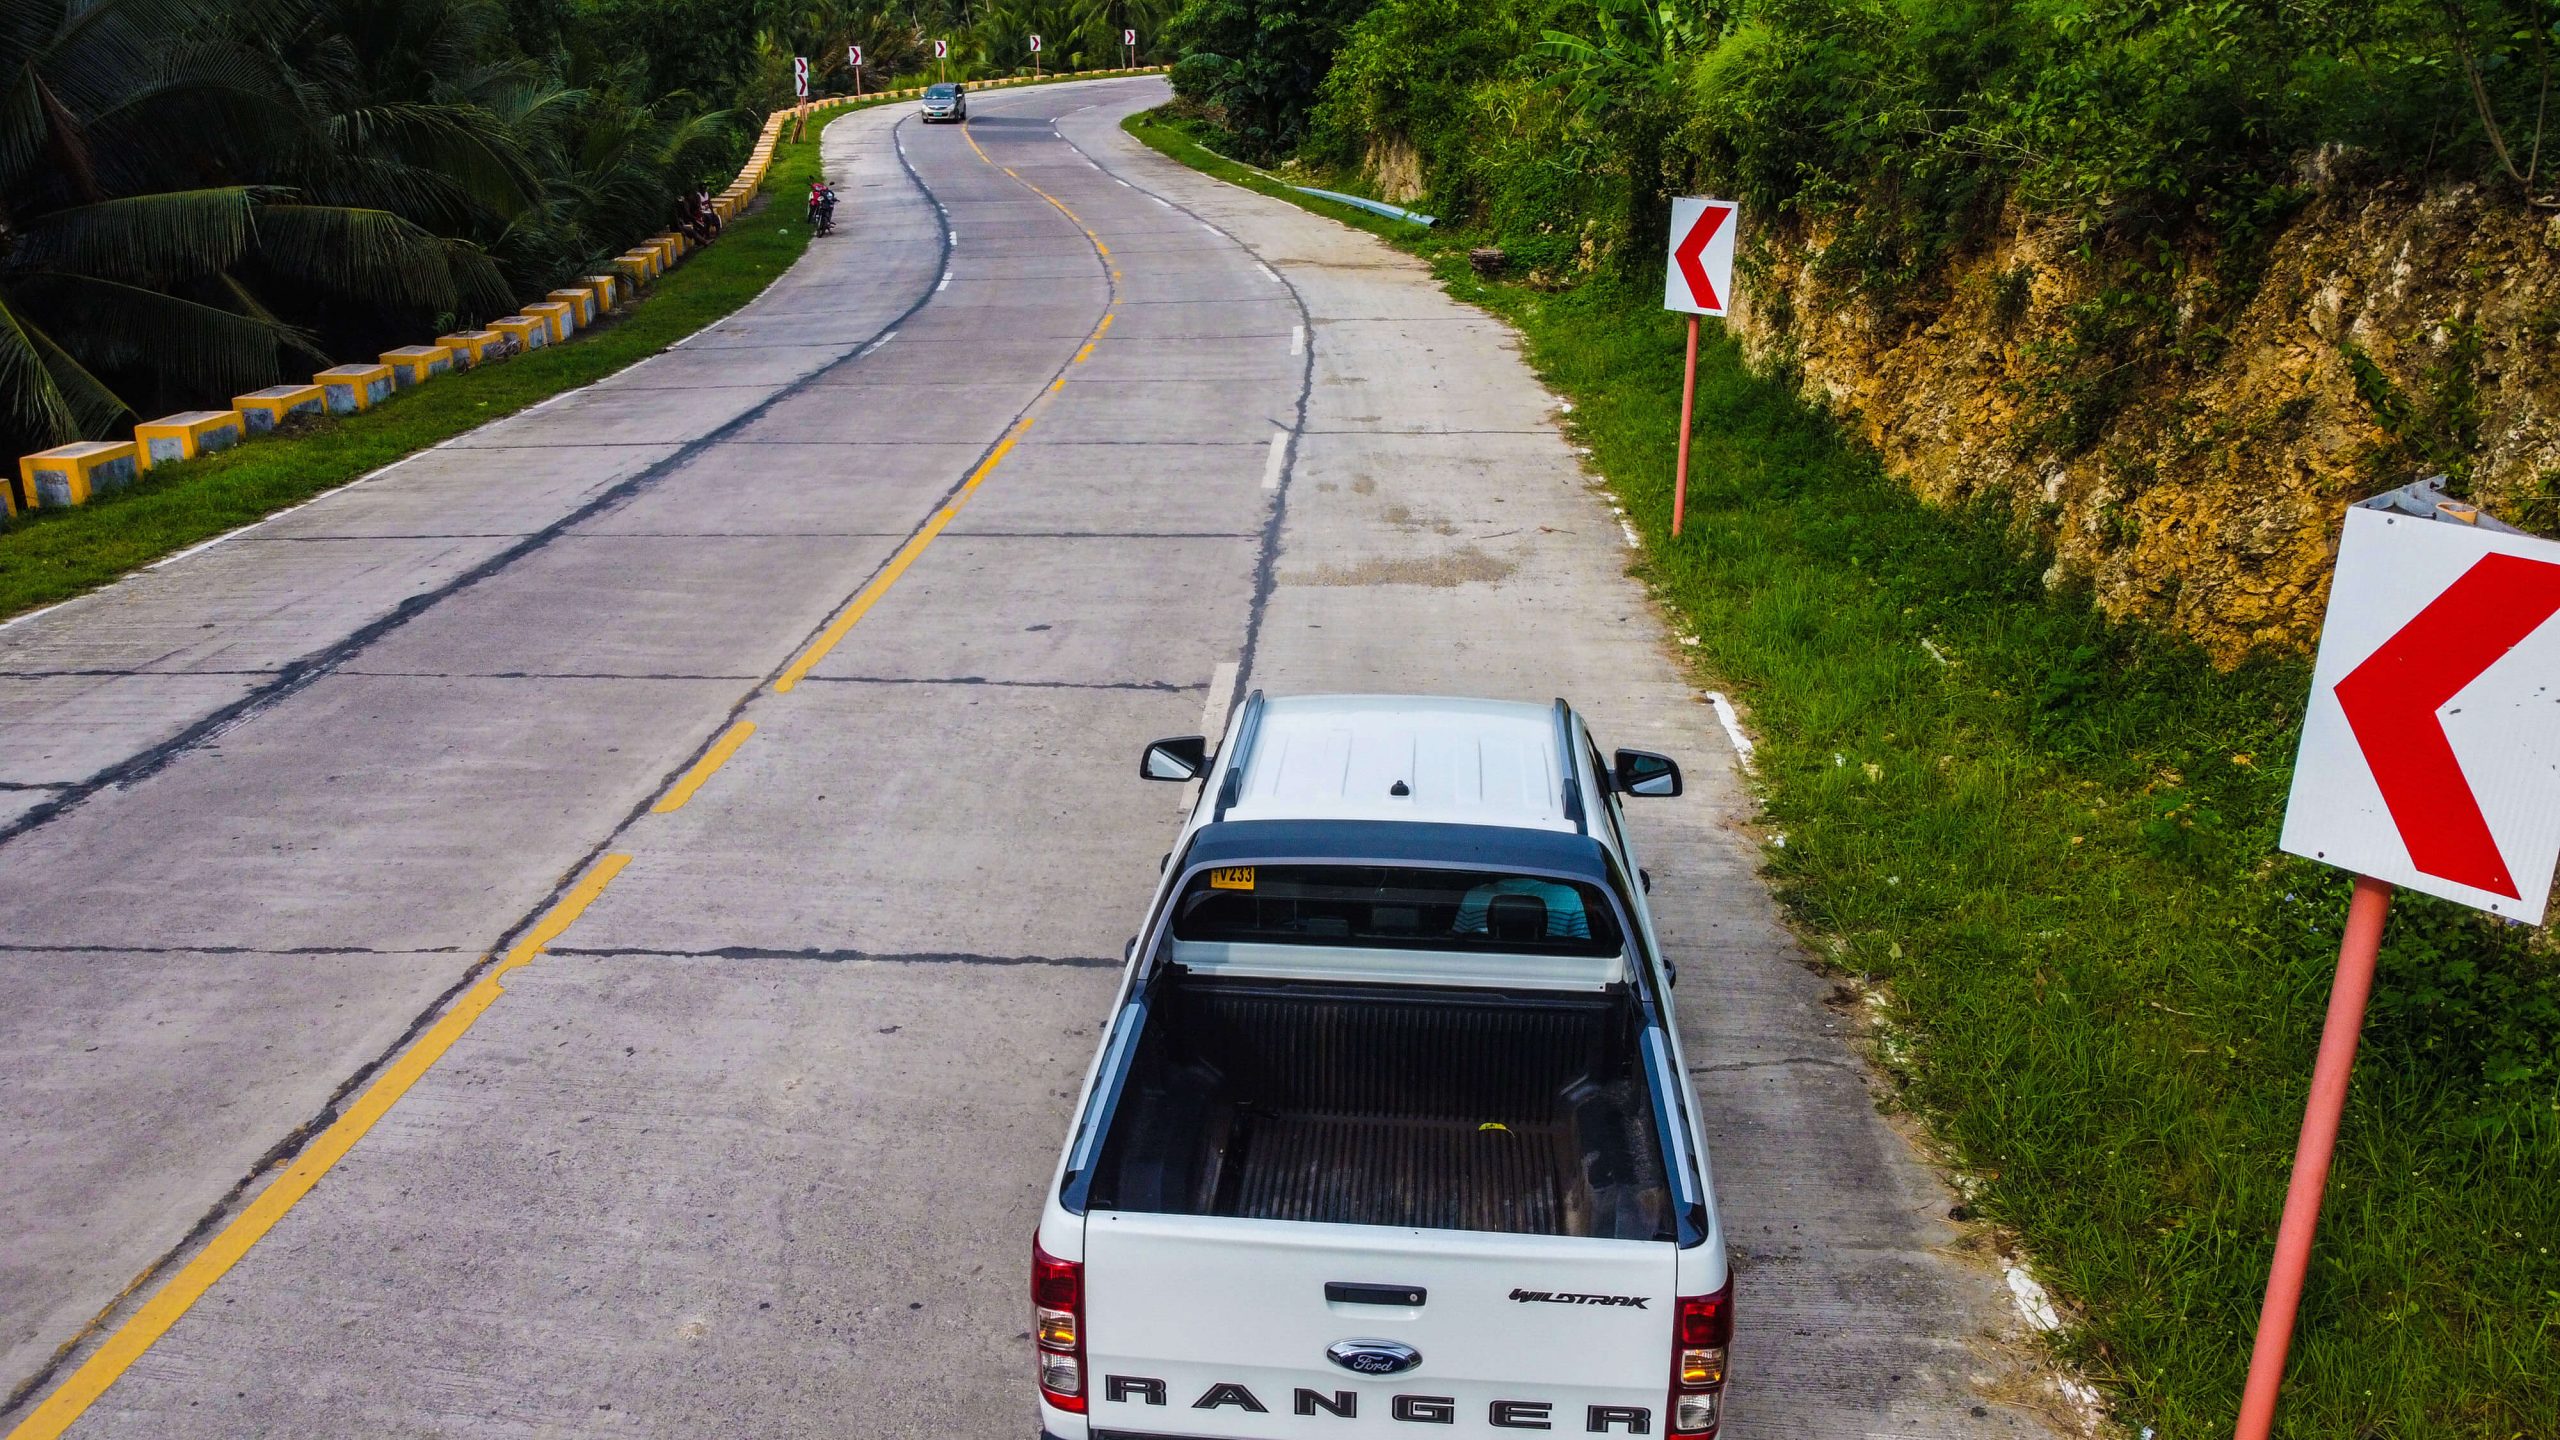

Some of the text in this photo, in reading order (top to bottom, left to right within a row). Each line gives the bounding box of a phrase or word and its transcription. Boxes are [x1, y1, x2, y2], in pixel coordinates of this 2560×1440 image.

[1508, 1288, 1652, 1310] WILDTRAK
[1353, 1354, 1394, 1371] Ford
[1105, 1374, 1652, 1435] RANGER
